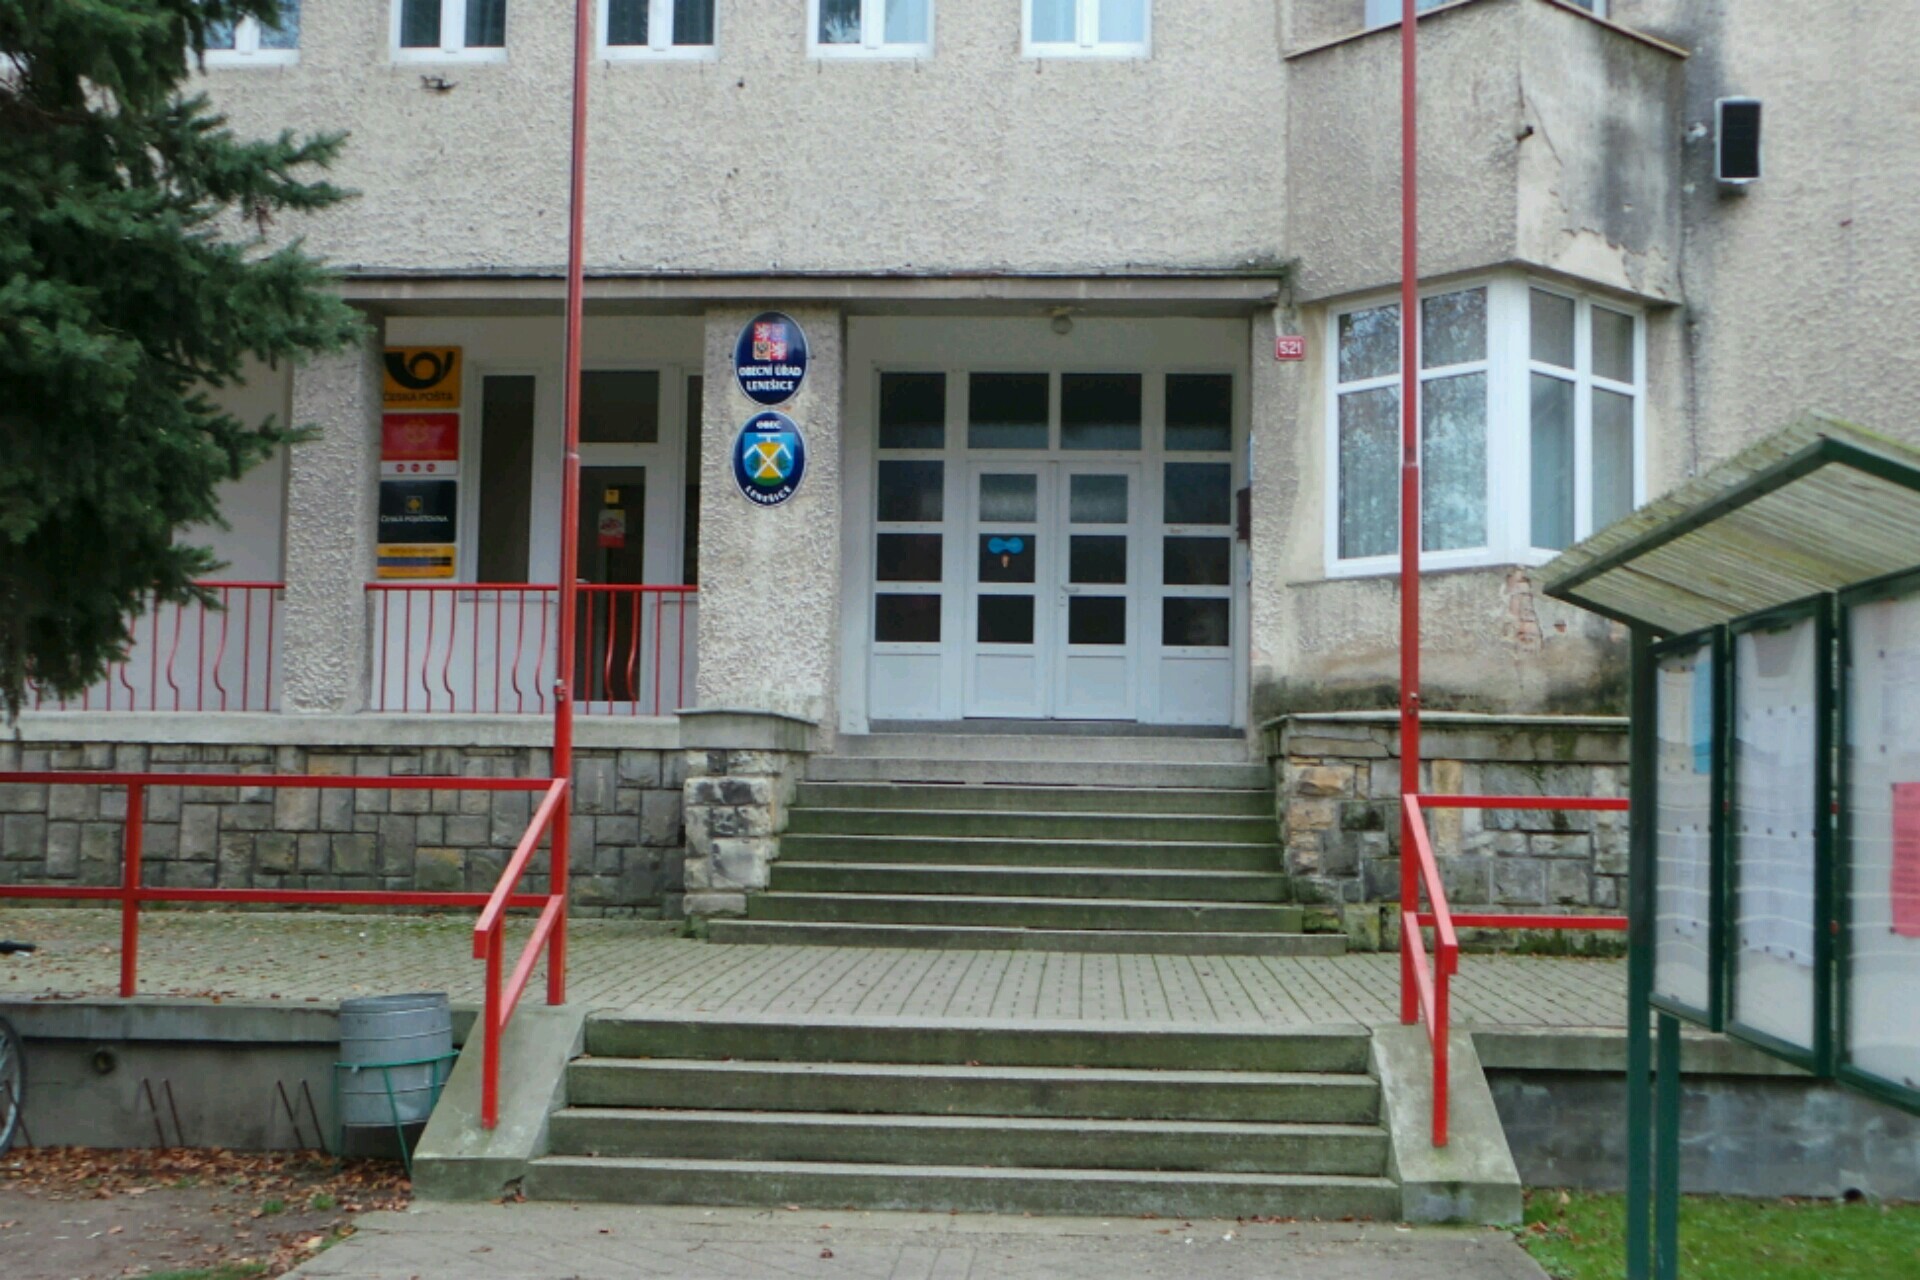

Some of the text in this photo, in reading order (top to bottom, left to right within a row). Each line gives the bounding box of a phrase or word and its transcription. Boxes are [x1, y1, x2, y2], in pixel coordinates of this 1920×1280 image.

[1279, 341, 1302, 354] 521
[739, 364, 802, 376] OBECNÍ ÚŘAD
[746, 379, 794, 391] LENEŠICE
[756, 420, 782, 429] OBEC
